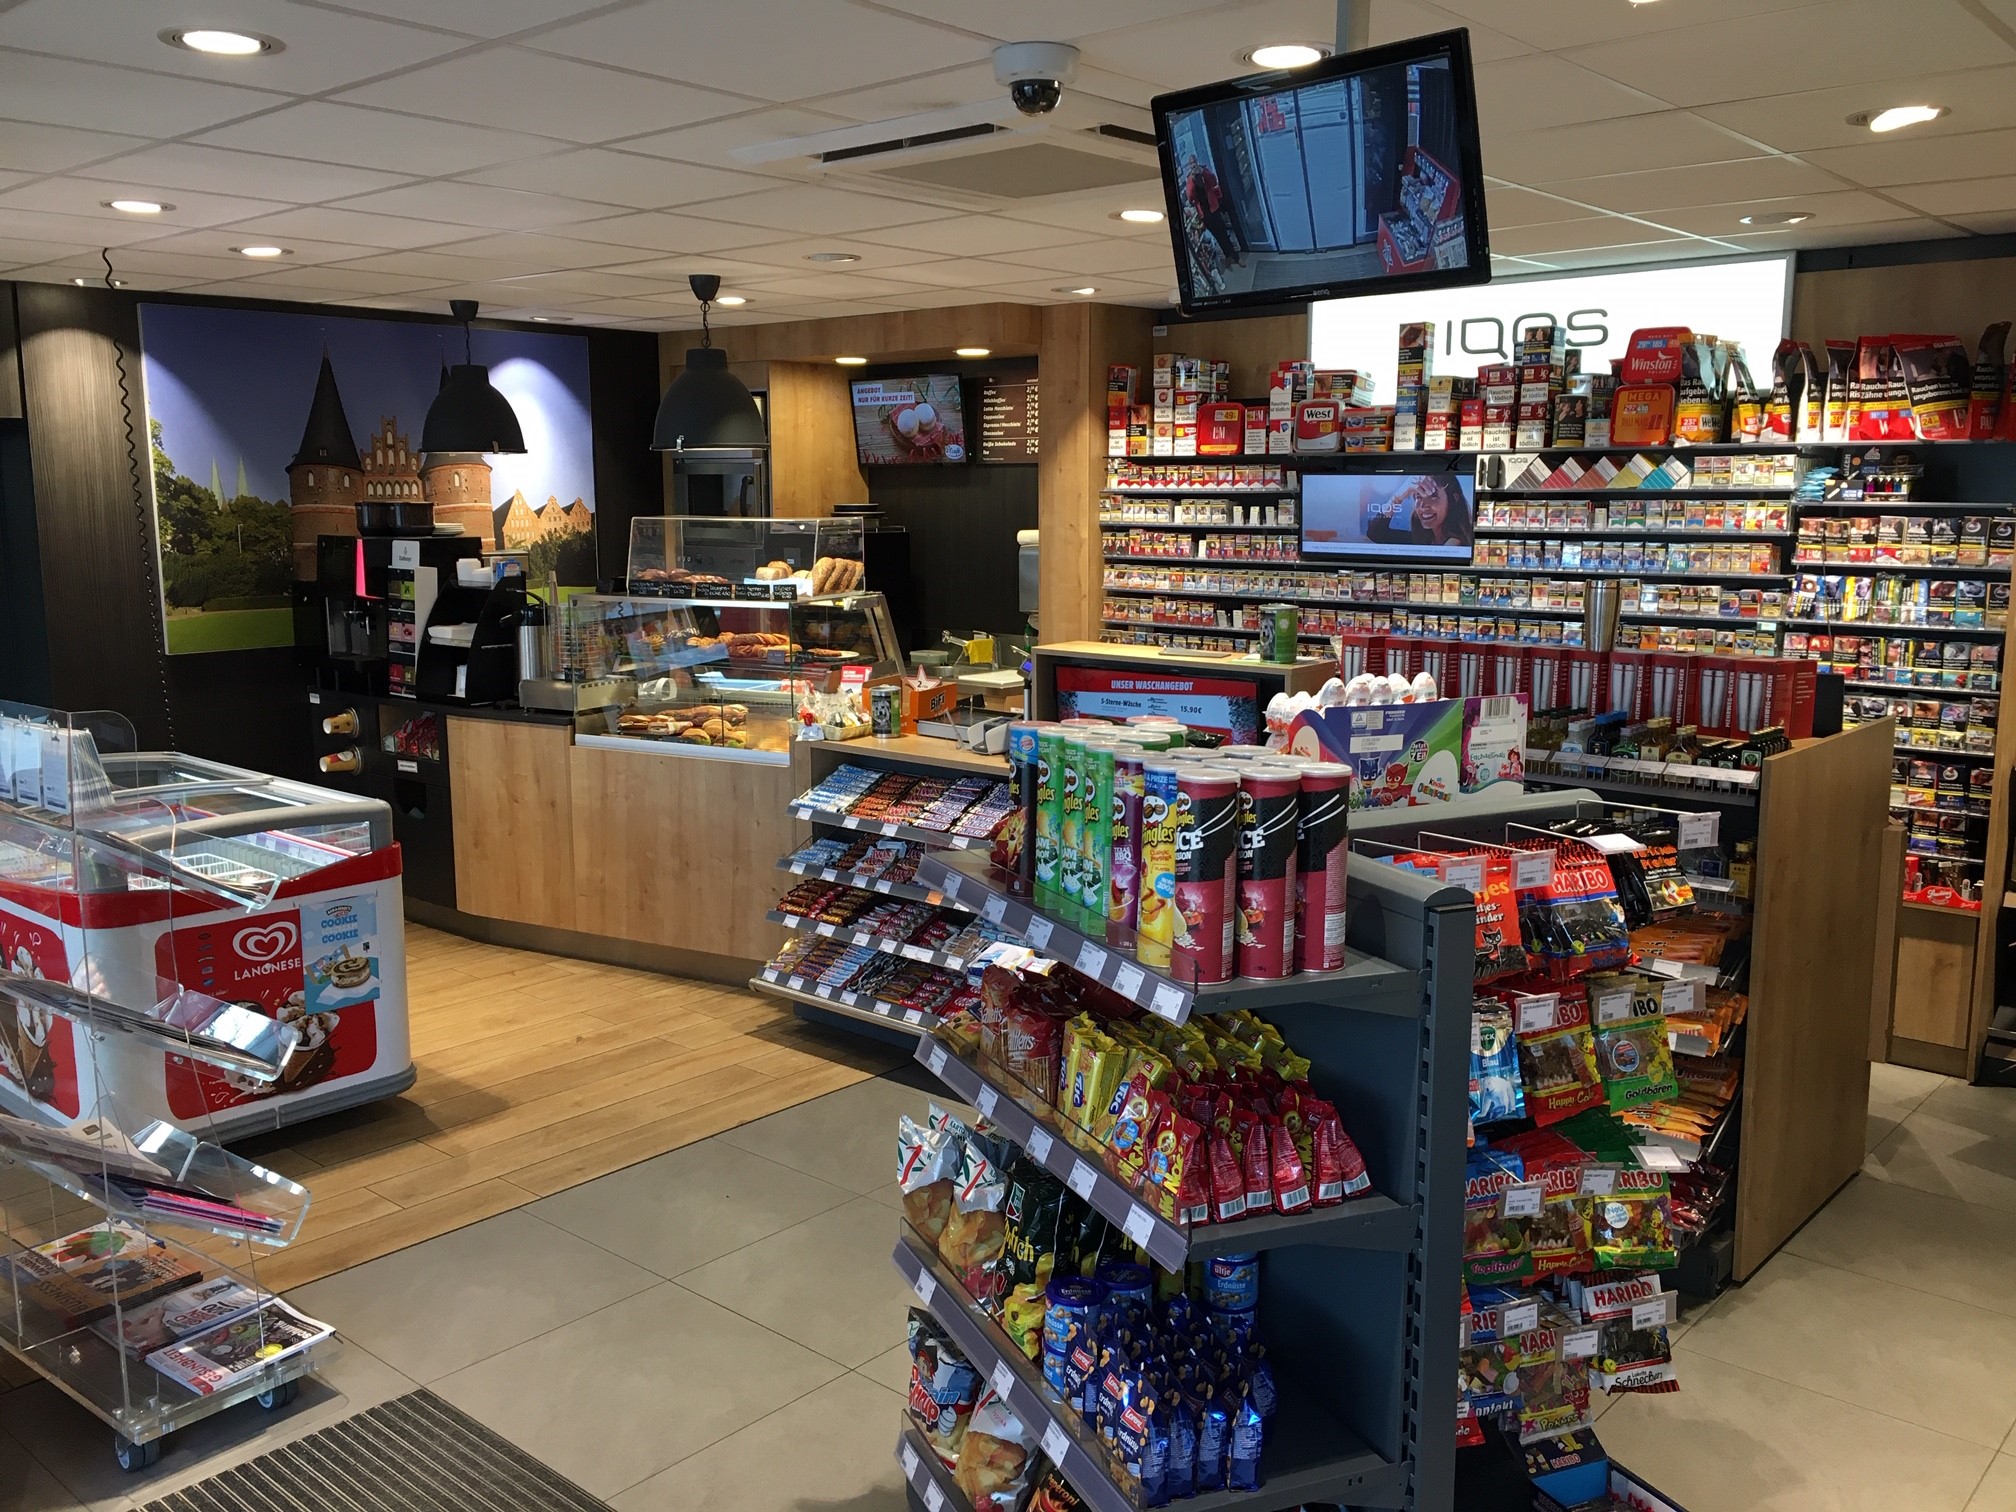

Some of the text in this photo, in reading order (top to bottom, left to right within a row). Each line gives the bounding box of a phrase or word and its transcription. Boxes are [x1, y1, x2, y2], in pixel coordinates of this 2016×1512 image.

[1446, 308, 1609, 360] IQOS
[1631, 357, 1672, 371] Winston
[1911, 384, 1939, 394] Rauchen
[1628, 392, 1659, 402] MEGA
[1306, 409, 1331, 419] West
[1519, 439, 1540, 447] tödlich
[1367, 503, 1403, 514] IQOS
[1111, 680, 1194, 691] UNSER WASCHANGEBOT
[1634, 665, 1644, 720] MEHRWEG-BECHER
[930, 692, 946, 711] BiFi
[1676, 668, 1685, 724] MEHRWEG-BECHER
[1725, 671, 1735, 728] MEHRWEG-BECHER
[1151, 775, 1169, 783] PRIZE
[1115, 852, 1131, 862] BBQ
[1553, 869, 1608, 893] HARIBO
[321, 914, 358, 929] COOKIE
[1476, 913, 1504, 924] inder
[321, 929, 359, 944] COOKIE
[234, 957, 302, 981] LANGNESE
[1632, 998, 1658, 1017] IBO
[1008, 1031, 1036, 1049] altletts
[1481, 1033, 1495, 1041] VICK
[1482, 1059, 1499, 1067] Blau
[1074, 1074, 1083, 1104] TUC
[1625, 1084, 1673, 1100] Goldbären
[1110, 1083, 1126, 1112] TUC
[1548, 1096, 1575, 1110] Happy
[1618, 1170, 1663, 1189] RIBO
[1607, 1205, 1624, 1215] Neu
[1214, 1264, 1231, 1276] ültje
[1538, 1259, 1567, 1271] Happy
[1217, 1280, 1246, 1289] Erdnüsse
[37, 1280, 91, 1313] BUSINESS
[1593, 1281, 1655, 1308] HARIBO
[1075, 1349, 1090, 1366] Lorenz
[163, 1349, 222, 1383] GESUNDHEIT
[1614, 1371, 1663, 1387] Schnecken
[1124, 1409, 1143, 1430] Lorenz
[1550, 1454, 1581, 1469] HARIBO
[1048, 1472, 1080, 1506] Peperoni
